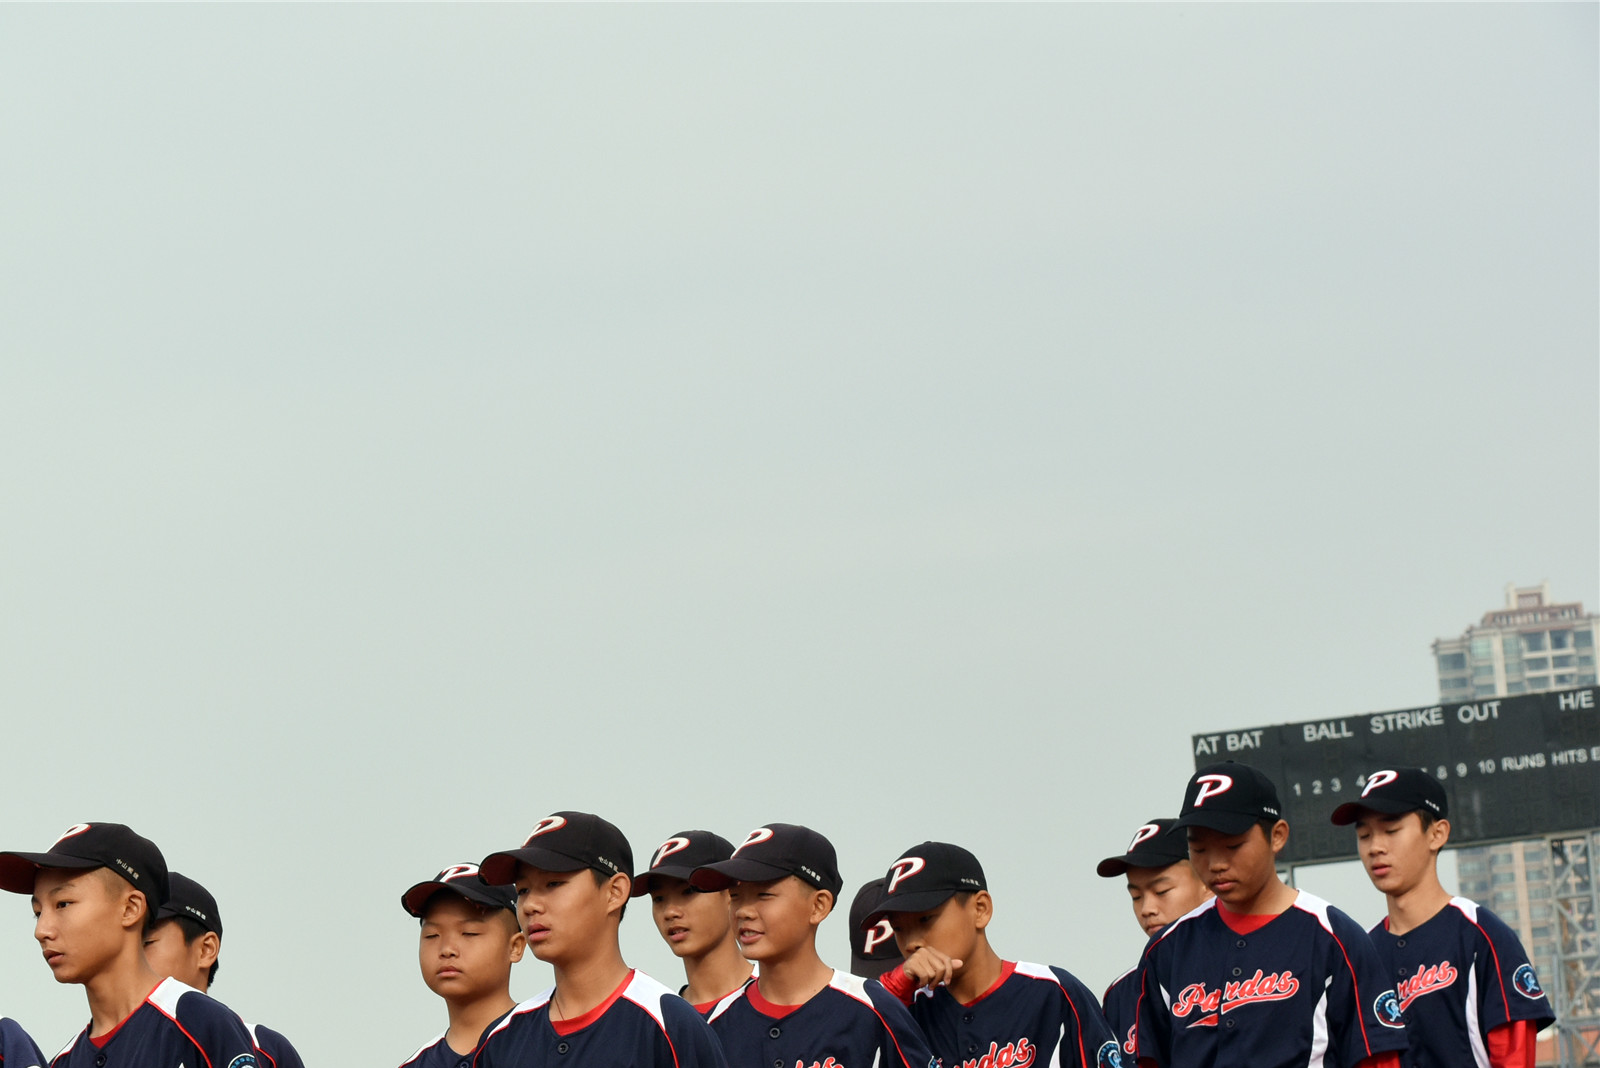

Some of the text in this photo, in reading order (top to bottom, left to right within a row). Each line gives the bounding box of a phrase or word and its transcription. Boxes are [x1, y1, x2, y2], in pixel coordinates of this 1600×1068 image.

[1195, 689, 1596, 756] AT BAT BALL STRIKE OUT H/E
[1312, 780, 1323, 795] 2
[1331, 777, 1342, 792] 3
[1436, 765, 1448, 780] 8
[1456, 762, 1468, 777] 9
[1477, 758, 1496, 774] 10
[1501, 752, 1546, 772] RUNS
[1551, 748, 1588, 766] HITS
[1361, 769, 1398, 799] P
[1193, 773, 1234, 808] P
[520, 814, 568, 849] P
[730, 827, 775, 861] P
[1127, 823, 1160, 852] P
[651, 836, 690, 870] P
[888, 856, 926, 894] P
[862, 918, 894, 954] P
[1171, 969, 1300, 1029] Pandas
